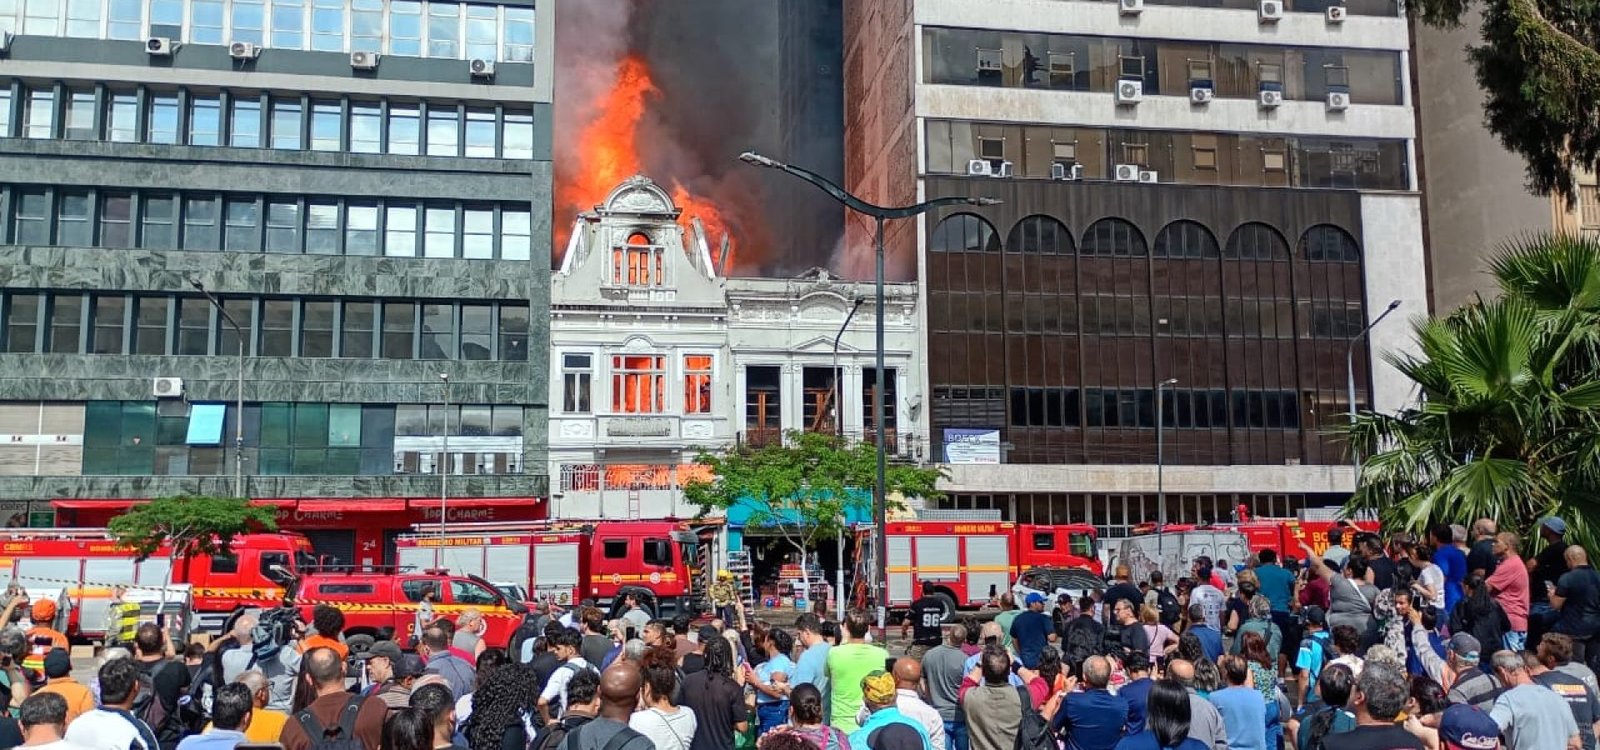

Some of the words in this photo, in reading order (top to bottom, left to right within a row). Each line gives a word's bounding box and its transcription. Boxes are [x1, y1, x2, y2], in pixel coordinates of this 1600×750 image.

[294, 509, 343, 520] CHARME
[447, 507, 494, 520] CHARME
[362, 540, 376, 550] 24
[454, 537, 482, 546] MILITAR
[923, 613, 940, 627] 96
